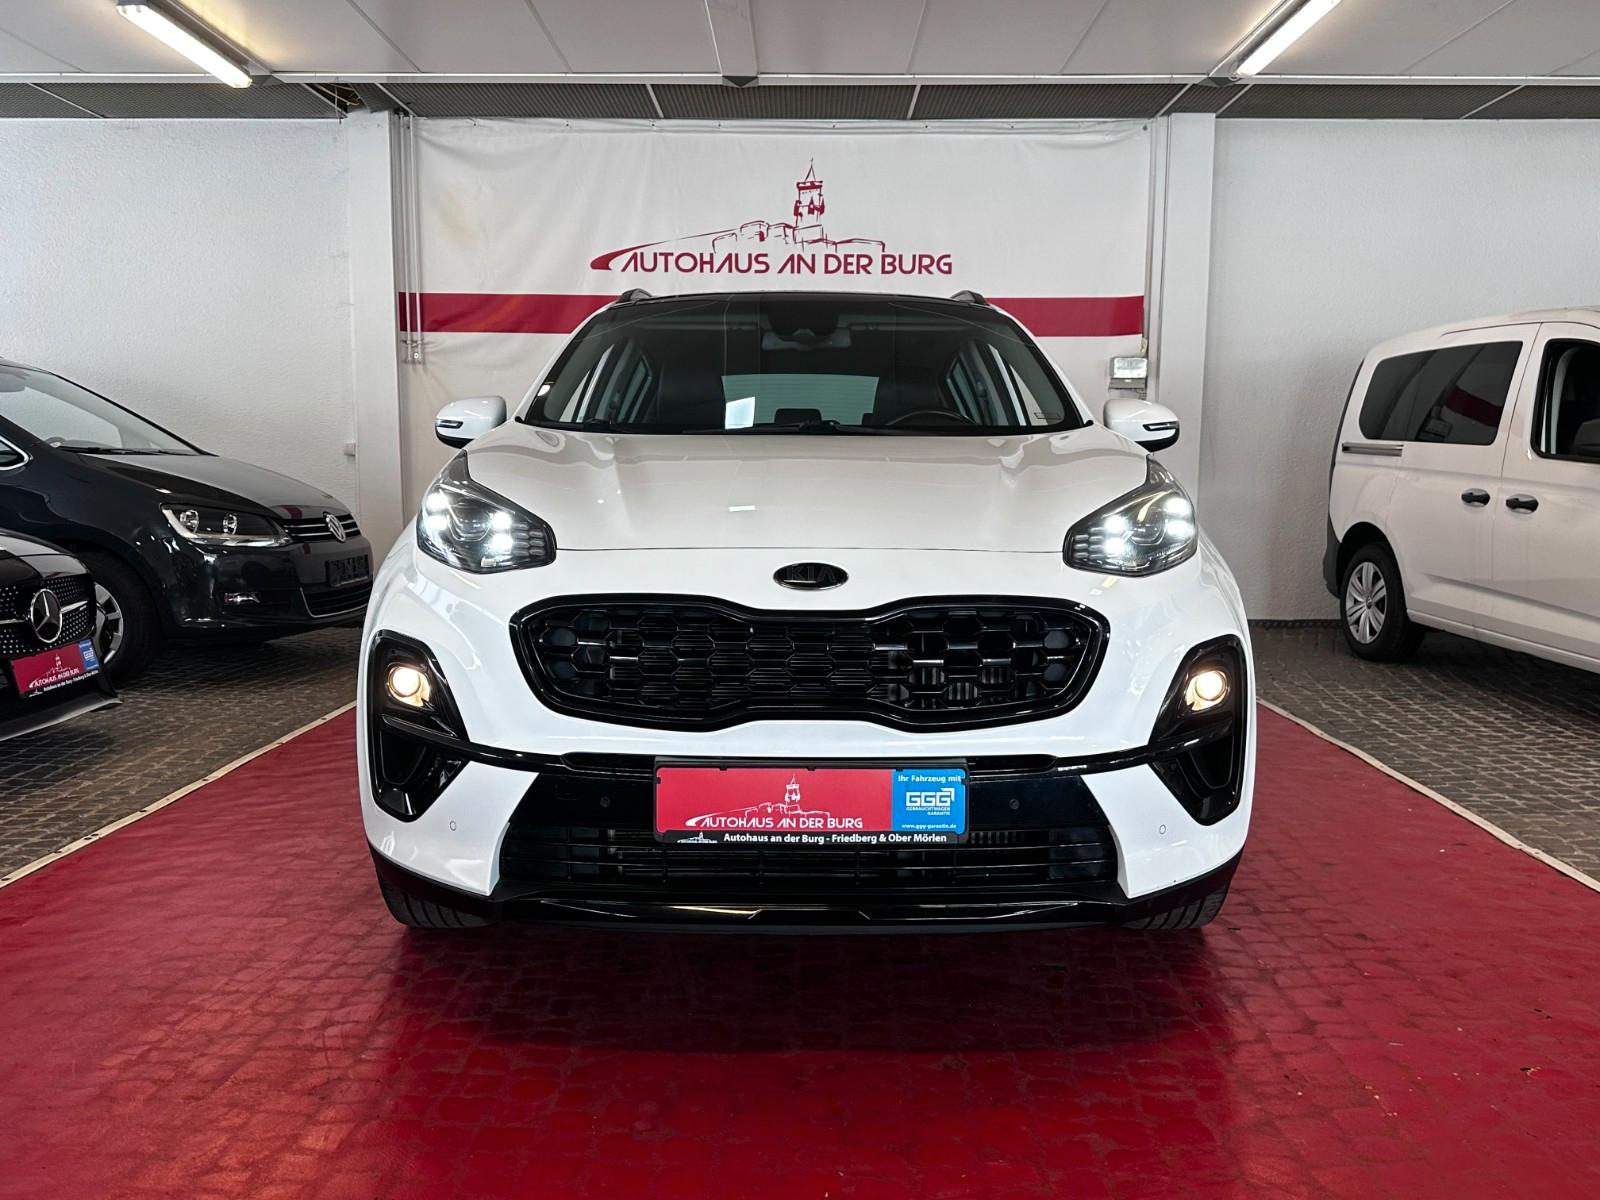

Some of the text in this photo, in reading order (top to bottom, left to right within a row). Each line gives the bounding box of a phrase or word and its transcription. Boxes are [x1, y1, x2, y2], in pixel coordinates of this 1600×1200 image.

[620, 252, 953, 275] AUTOHAUS AN DER BURG
[911, 775, 946, 783] Fahrzeug
[905, 791, 951, 807] GGG
[700, 816, 863, 829] AUTOHAUS AN DER BURG
[723, 833, 769, 842] Autohaus
[770, 834, 782, 842] an
[783, 833, 800, 843] der
[801, 834, 825, 845] Burg
[831, 834, 878, 844] Friedberg
[879, 833, 887, 843] &
[888, 833, 912, 842] Ober
[913, 833, 947, 842] Mörlen
